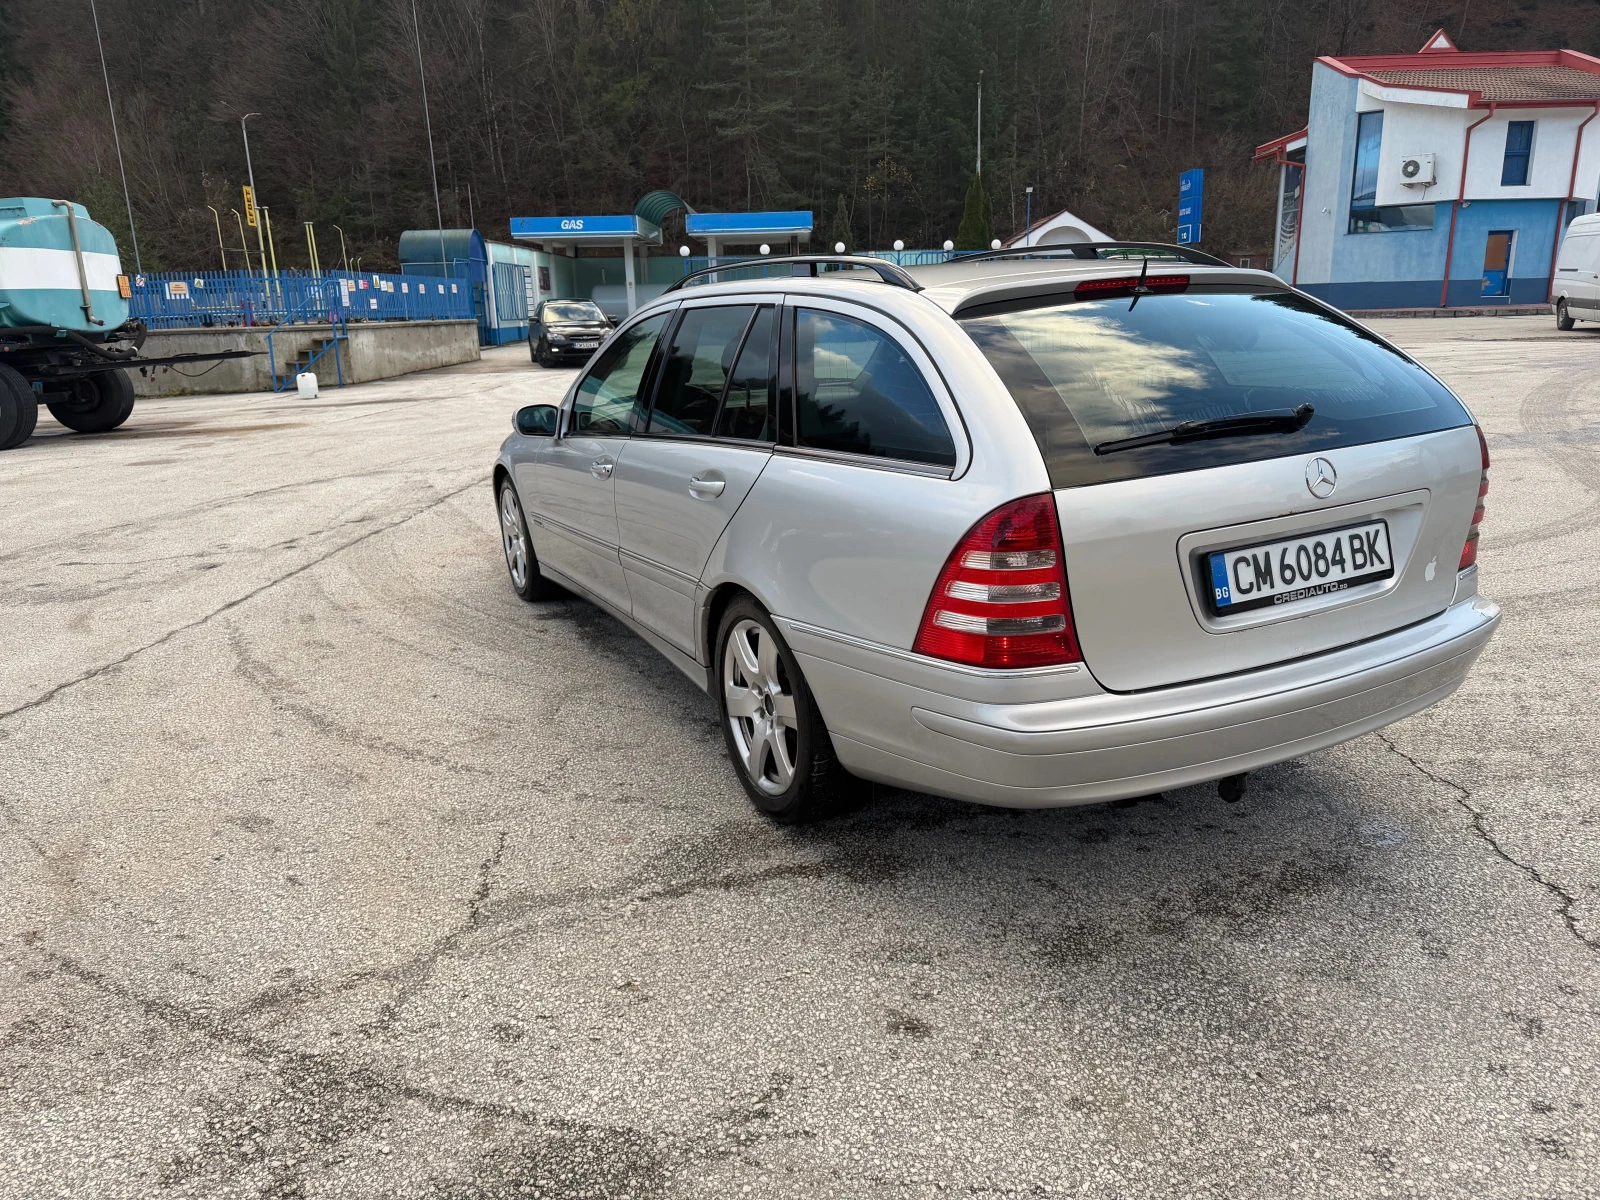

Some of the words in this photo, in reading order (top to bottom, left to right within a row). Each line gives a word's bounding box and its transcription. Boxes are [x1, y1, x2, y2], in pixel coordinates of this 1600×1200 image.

[245, 189, 254, 223] EFBET
[561, 219, 584, 230] GAS
[1215, 586, 1229, 600] BG
